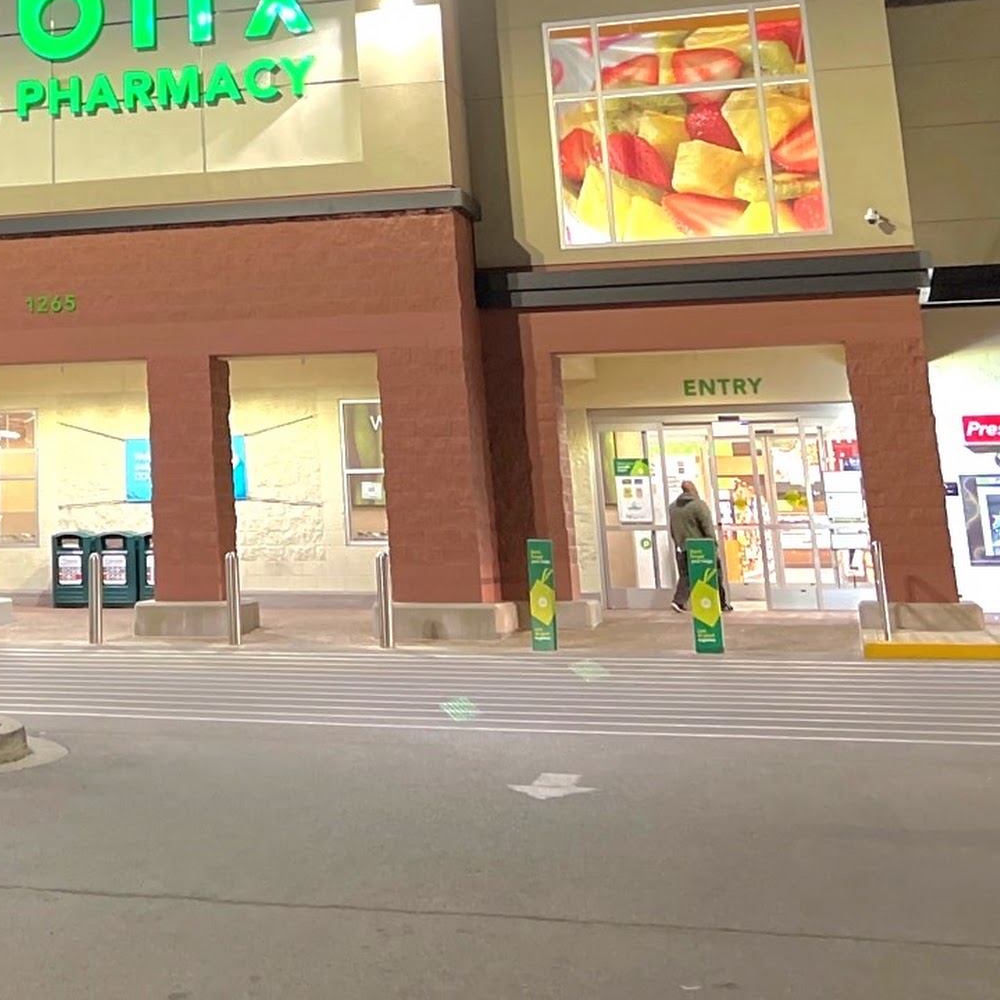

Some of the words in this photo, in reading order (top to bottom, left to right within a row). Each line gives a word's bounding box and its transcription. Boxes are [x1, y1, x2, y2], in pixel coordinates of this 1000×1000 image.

[16, 56, 314, 119] PHARMACY
[25, 294, 77, 313] 1265
[684, 377, 762, 397] ENTRY
